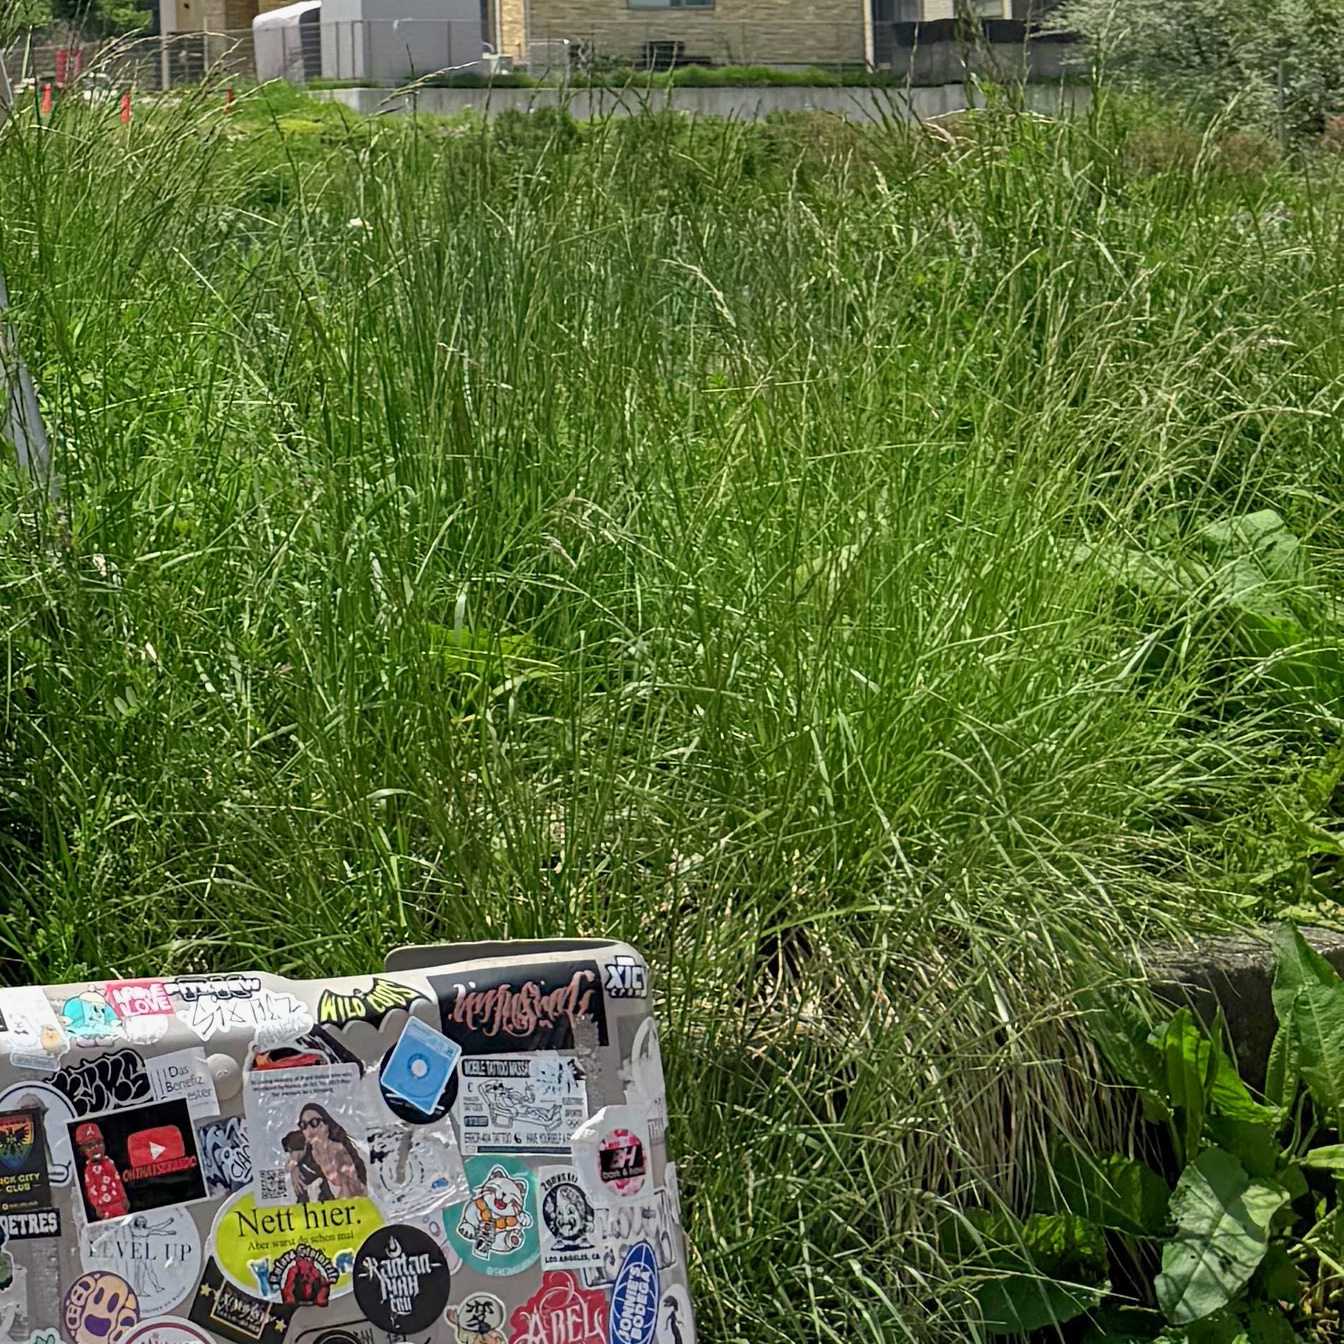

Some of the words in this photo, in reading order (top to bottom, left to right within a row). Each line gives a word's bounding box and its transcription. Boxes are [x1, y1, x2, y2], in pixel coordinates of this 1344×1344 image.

[320, 991, 366, 1023] WILD
[169, 1066, 189, 1078] Das
[234, 1207, 293, 1238] Nett
[303, 1202, 362, 1229] hier.
[165, 1242, 192, 1261] UP
